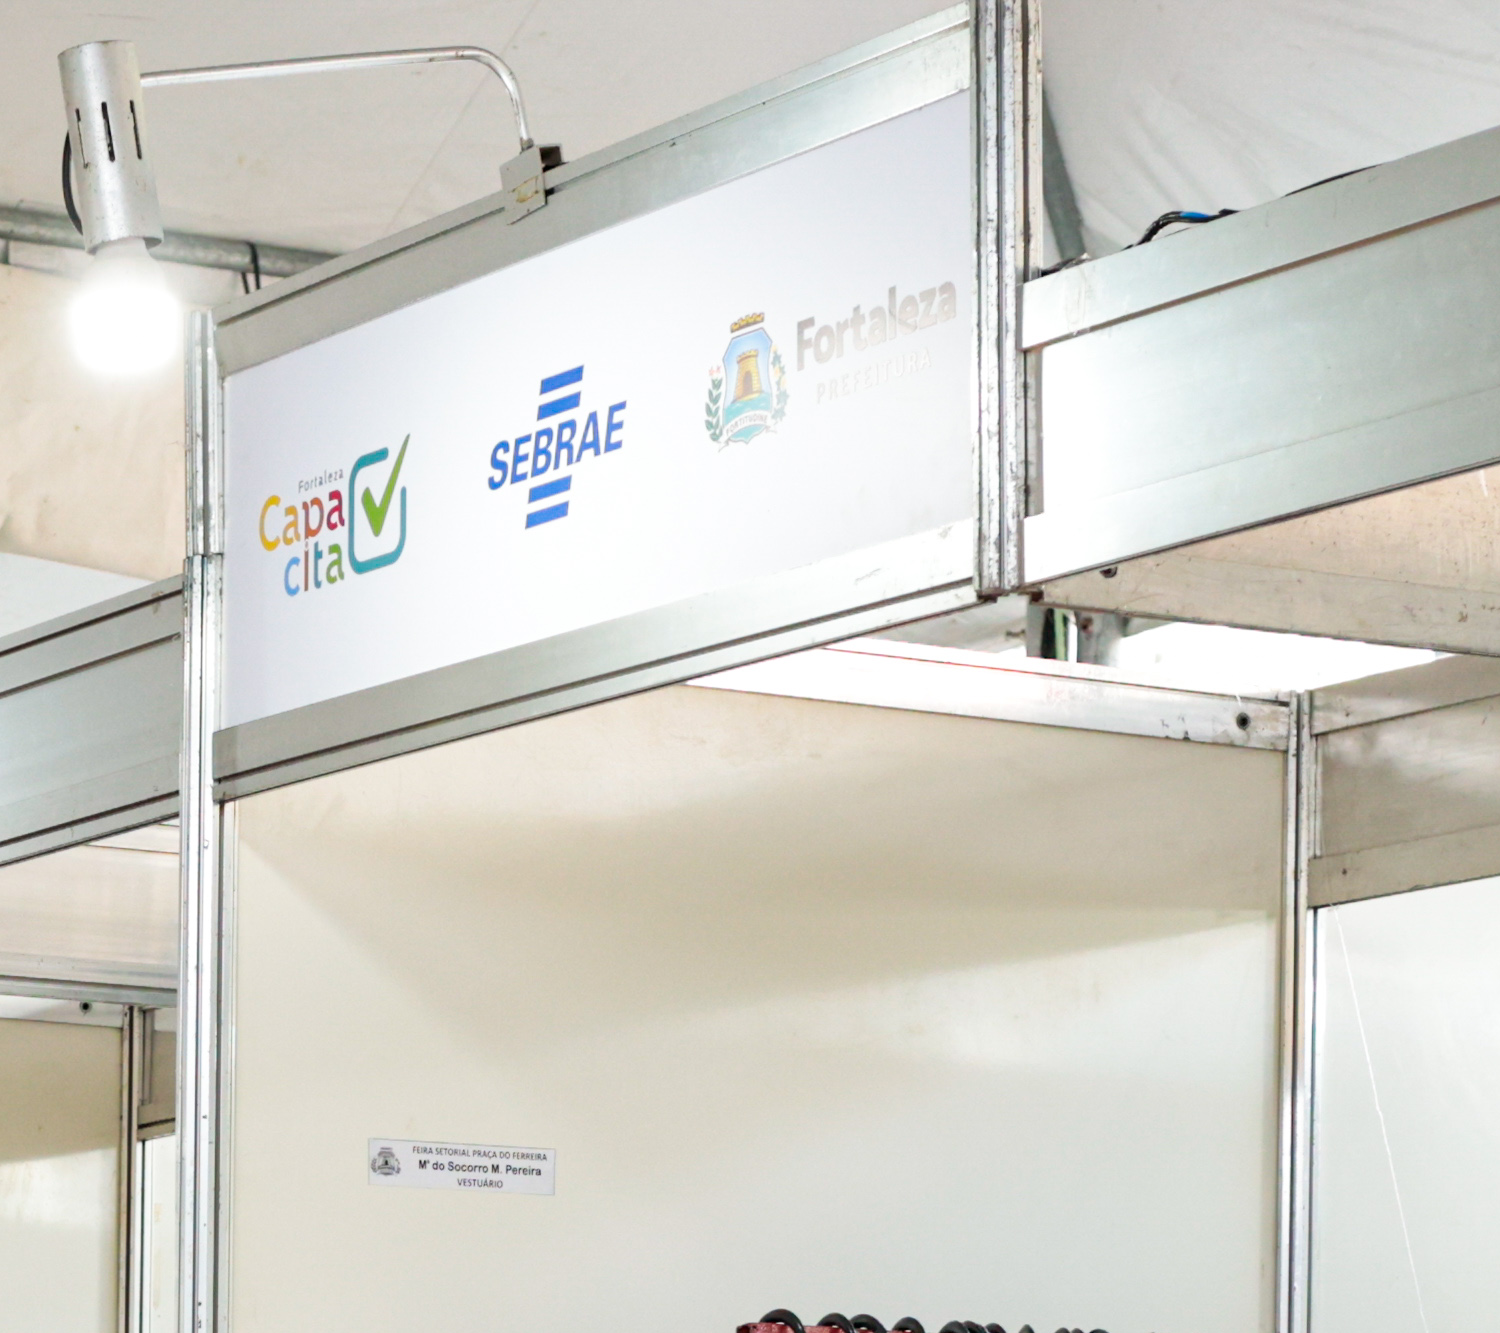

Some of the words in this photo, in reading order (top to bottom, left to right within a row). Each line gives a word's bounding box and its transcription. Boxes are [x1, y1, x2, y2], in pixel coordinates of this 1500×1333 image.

[797, 281, 957, 371] Fortaleza
[815, 346, 932, 404] PREFEITURA
[487, 400, 627, 491] SEBRAE
[298, 468, 344, 494] Fortaleza
[258, 489, 345, 552] Capa
[284, 540, 345, 596] cita
[413, 1146, 433, 1155] FEIRA
[435, 1148, 470, 1157] SETORIAL
[472, 1151, 497, 1160] PRAÇA
[500, 1151, 510, 1159] DO
[512, 1152, 547, 1162] FERREIRA
[432, 1161, 445, 1171] do
[447, 1162, 489, 1174] Socorro
[491, 1164, 503, 1174] M.
[505, 1165, 542, 1177] Pereira
[457, 1178, 503, 1188] VESTUÁRIO
